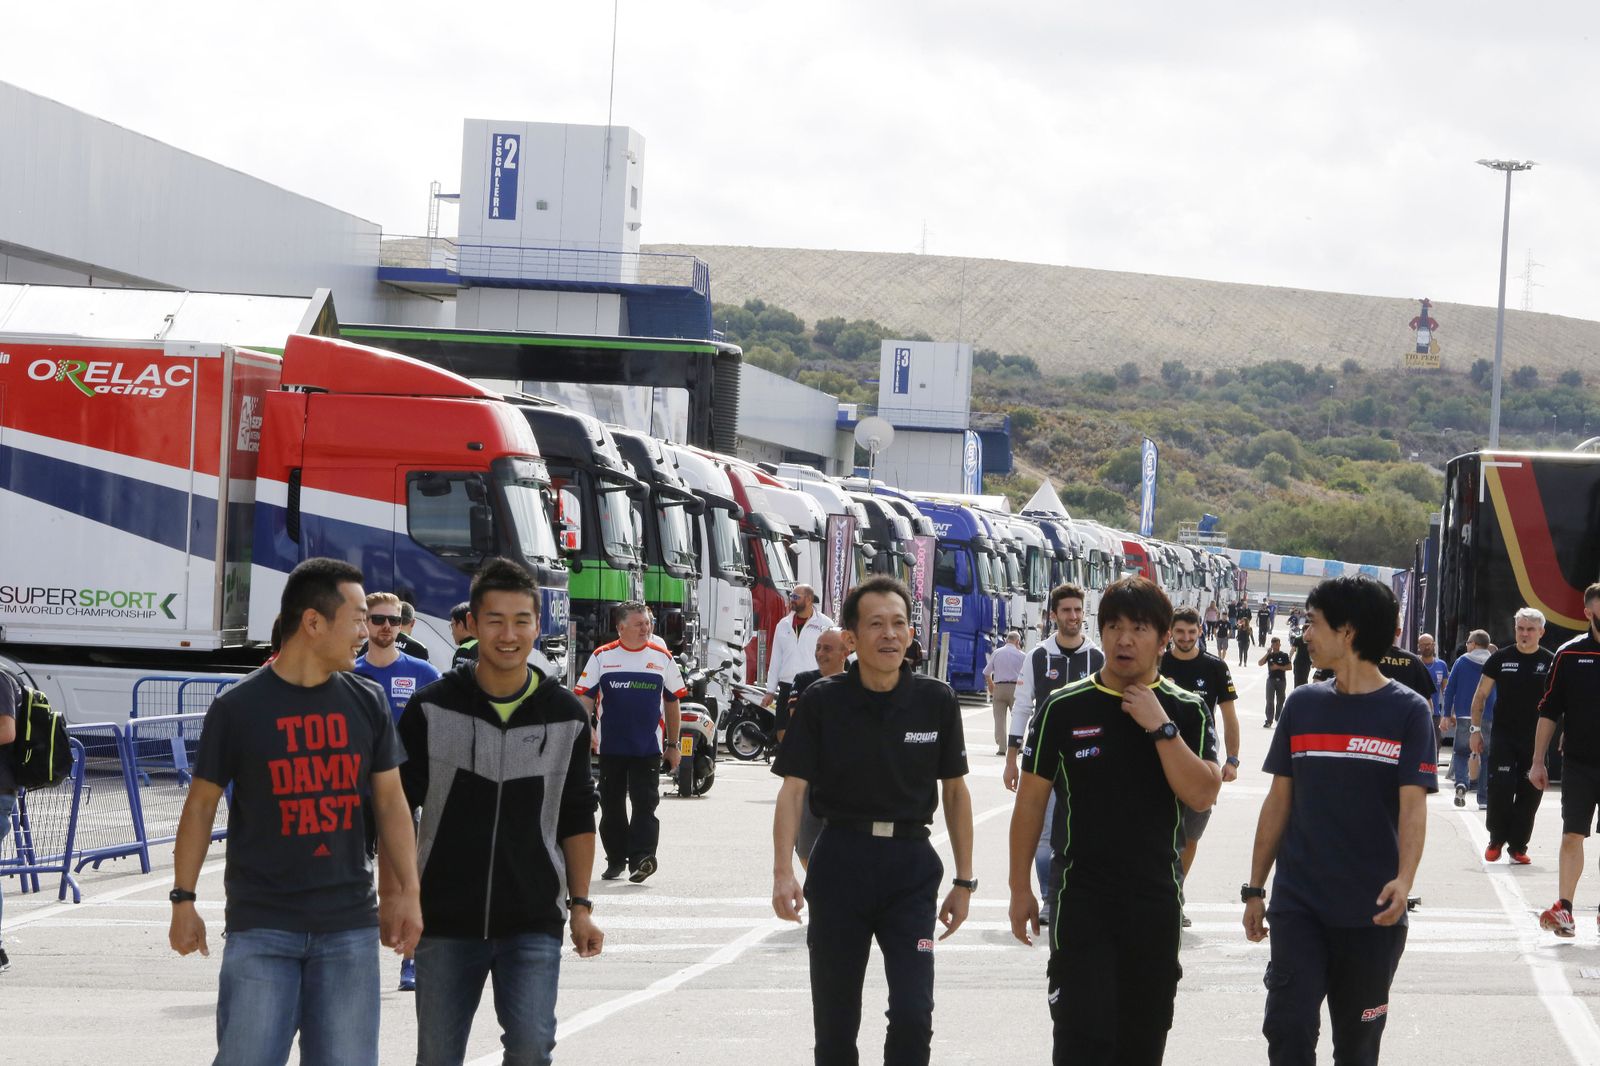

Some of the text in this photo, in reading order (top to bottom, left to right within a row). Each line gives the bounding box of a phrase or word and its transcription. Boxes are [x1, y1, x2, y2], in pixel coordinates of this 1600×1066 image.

[503, 138, 517, 169] 2
[492, 136, 502, 217] ESCALERA
[0, 352, 10, 364] in
[901, 350, 909, 367] 3
[27, 359, 192, 397] ORELAC
[21, 605, 64, 615] WORLD
[66, 608, 157, 619] CHAMPIONSHIP
[1380, 656, 1411, 666] STAFF
[609, 680, 657, 689] VerdNatura
[276, 713, 348, 752] TOO
[905, 731, 938, 741] SHOWA
[1075, 748, 1090, 758] elf
[1346, 738, 1402, 758] SHOWA
[268, 754, 361, 795] DAMN
[279, 795, 361, 836] FAST
